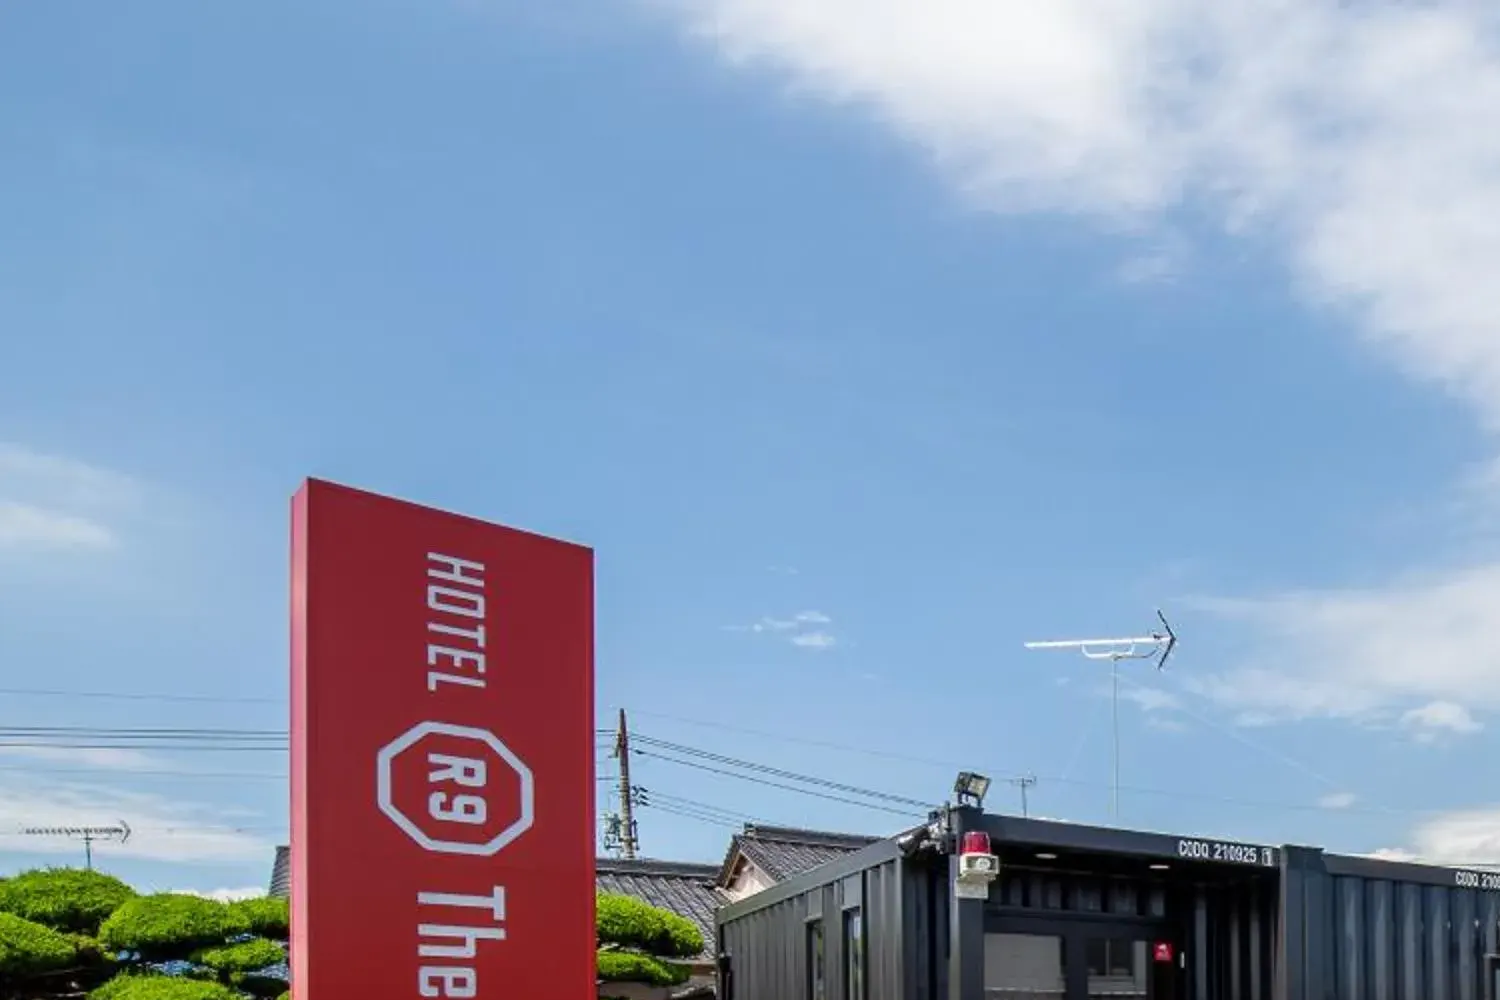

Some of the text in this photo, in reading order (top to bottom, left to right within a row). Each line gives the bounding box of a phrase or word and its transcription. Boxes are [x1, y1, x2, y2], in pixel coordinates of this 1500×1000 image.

[427, 552, 486, 691] HOTEL
[428, 753, 487, 824] R9
[1214, 843, 1258, 863] 210925
[417, 885, 506, 998] The
